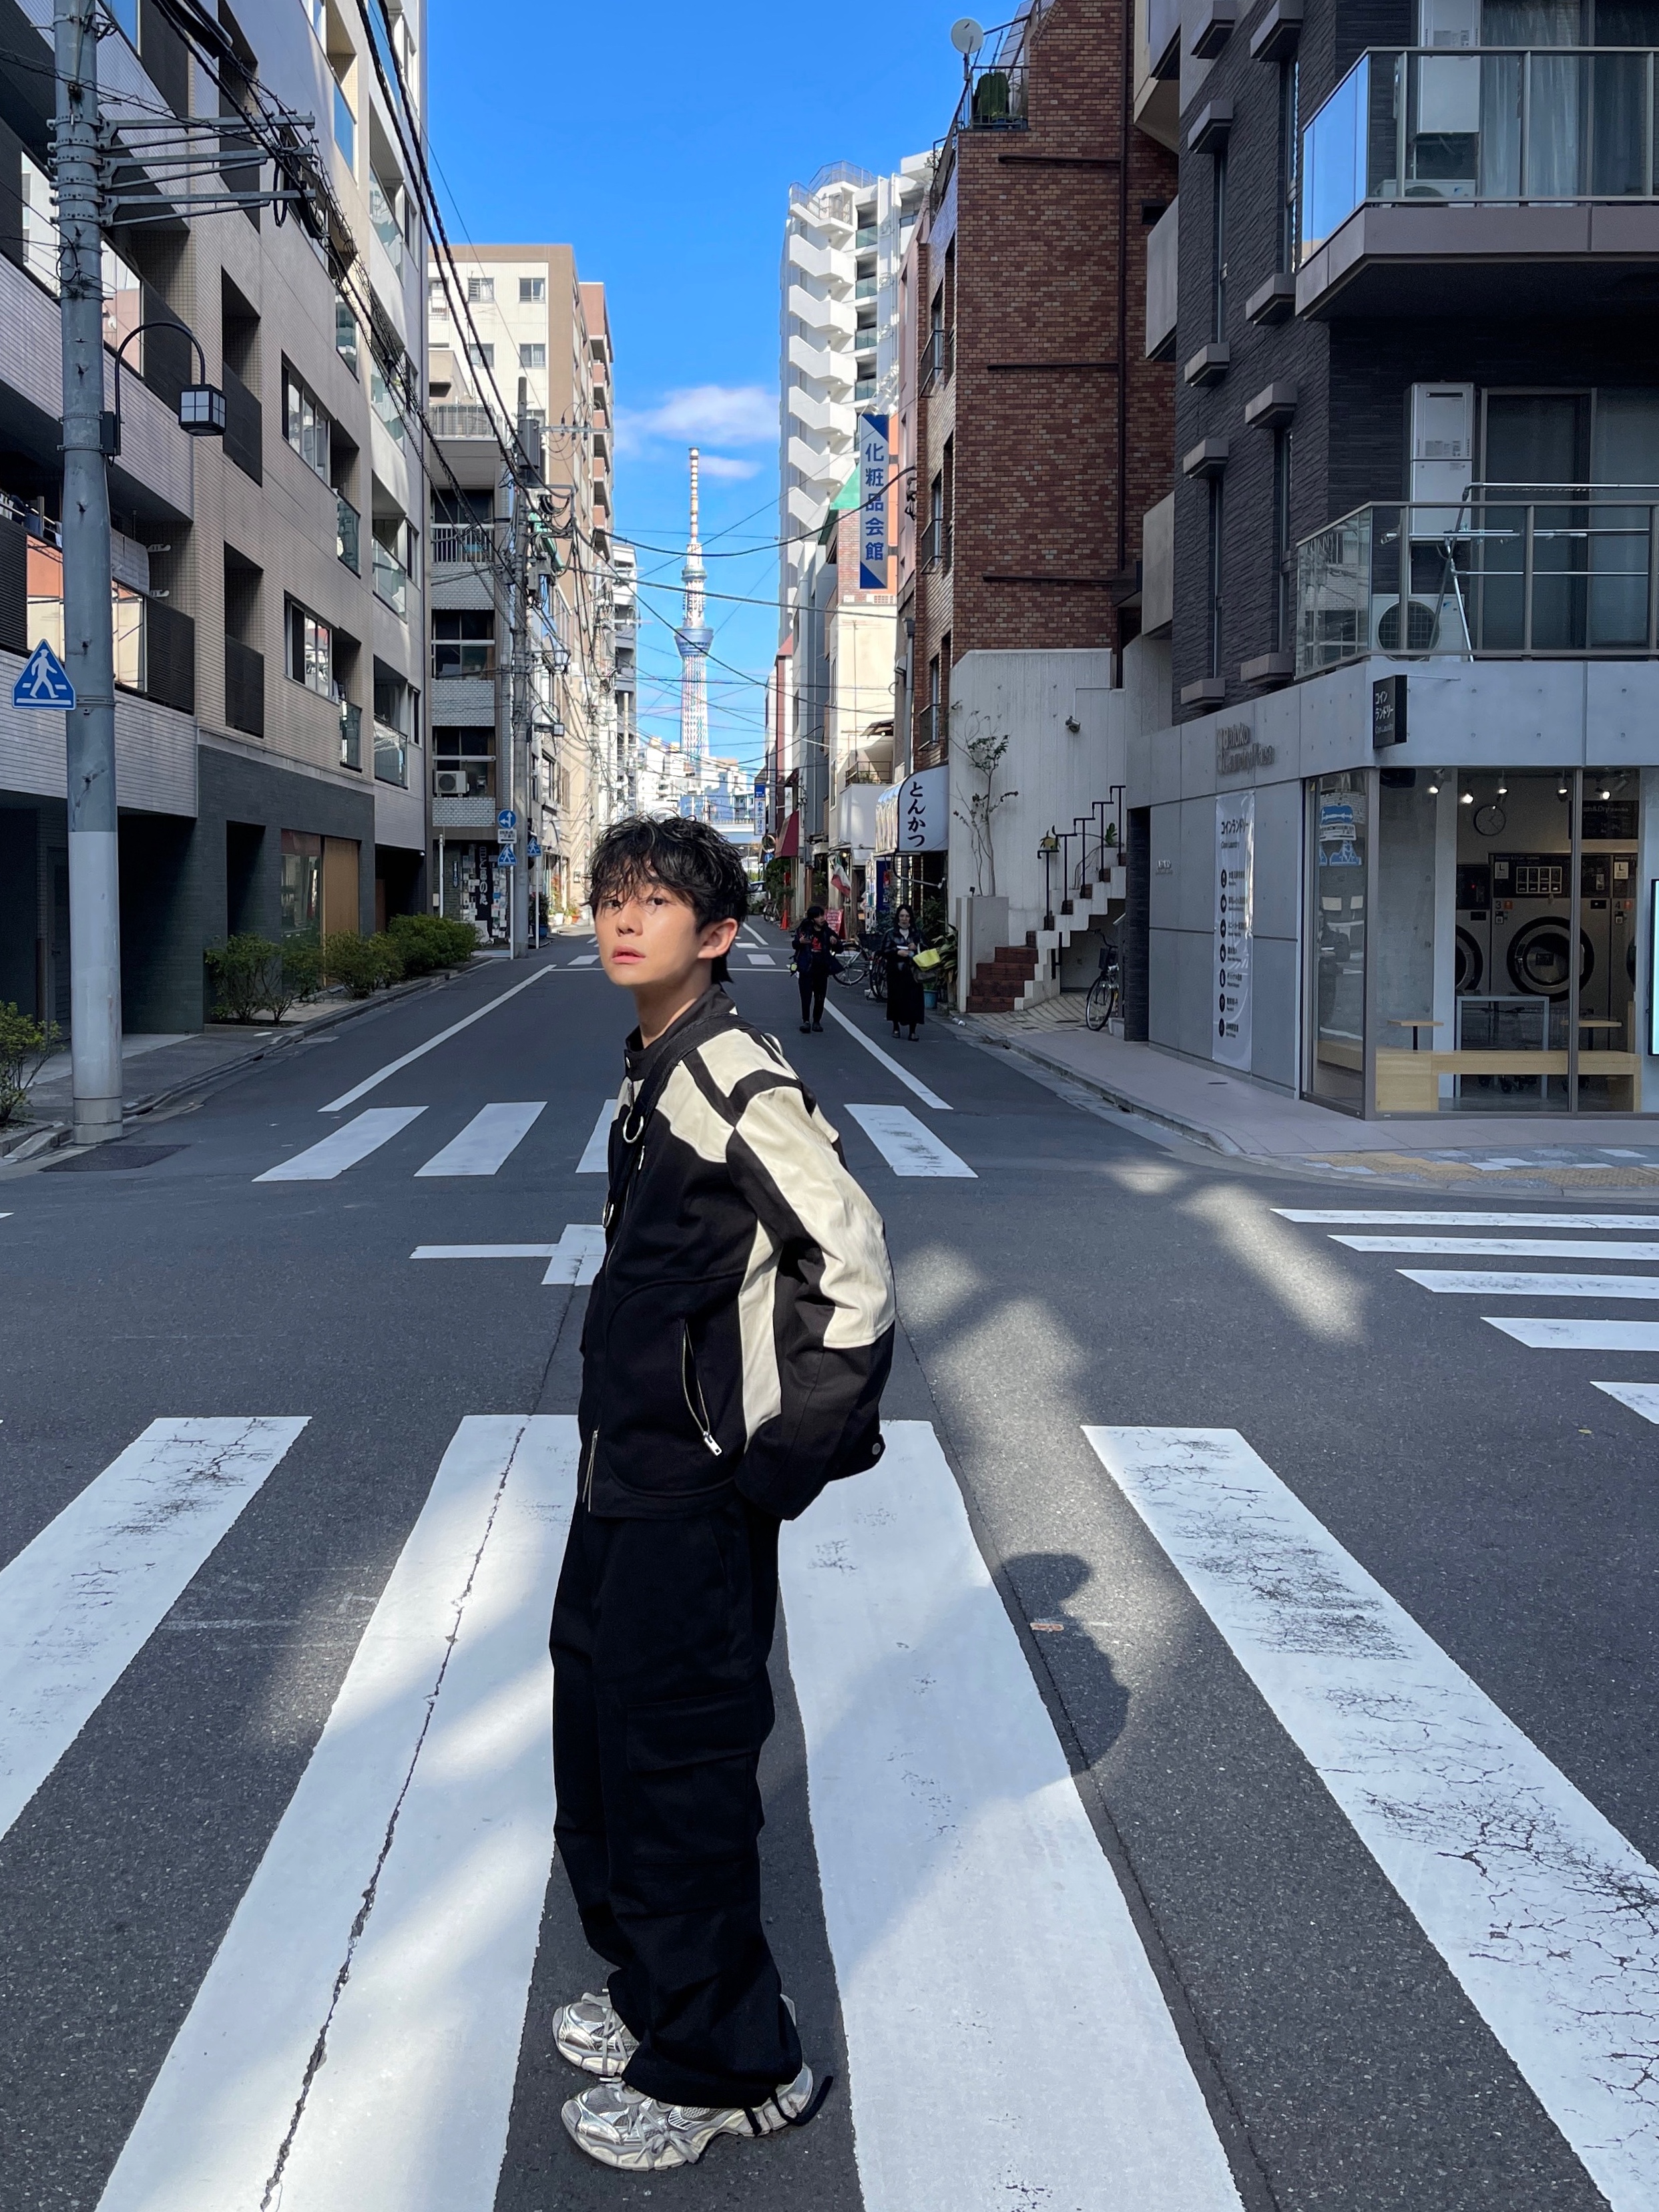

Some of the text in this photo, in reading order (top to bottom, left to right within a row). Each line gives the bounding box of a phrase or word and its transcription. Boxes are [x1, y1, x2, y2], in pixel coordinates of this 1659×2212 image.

[865, 443, 885, 561] 化粧品会館
[1375, 690, 1388, 705] コイン
[1375, 704, 1394, 721] ランドリー
[907, 781, 927, 848] とんかつ
[1221, 819, 1249, 835] コインランドリー
